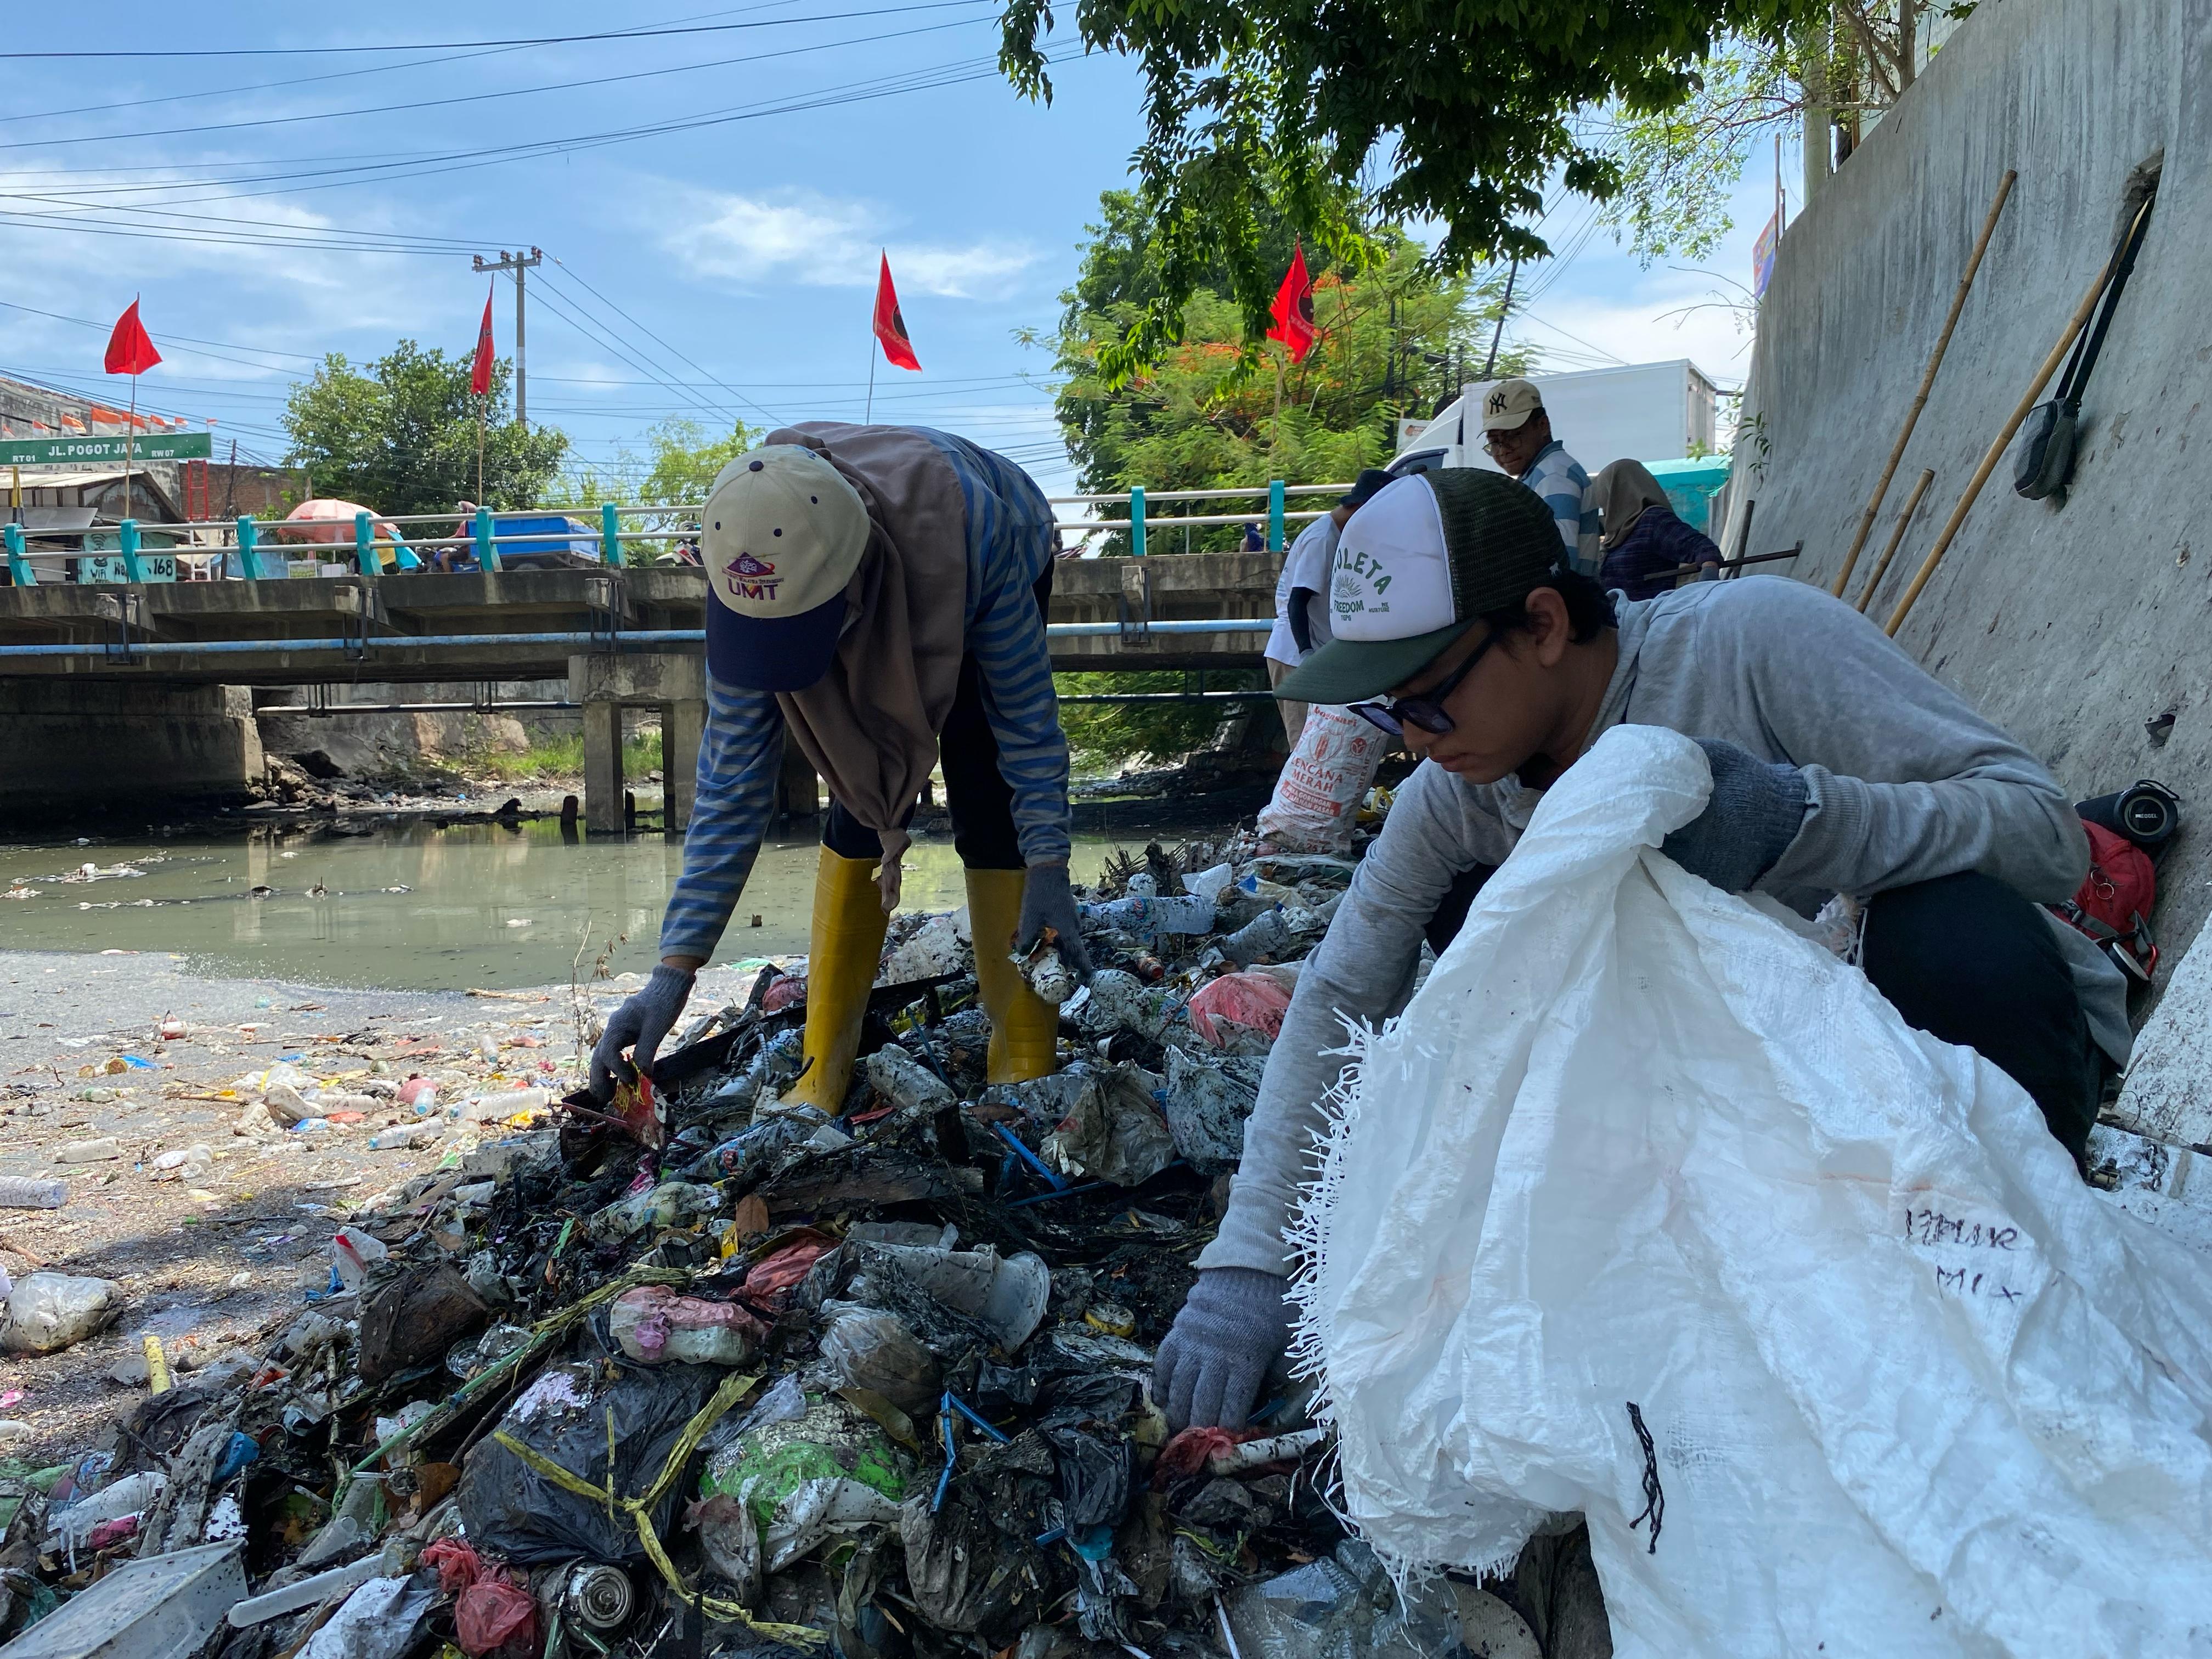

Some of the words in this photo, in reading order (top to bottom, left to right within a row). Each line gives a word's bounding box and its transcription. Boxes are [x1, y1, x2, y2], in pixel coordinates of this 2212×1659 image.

[48, 445, 66, 456] JL.
[68, 444, 110, 455] POGOT
[727, 578, 778, 600] UMT
[1334, 599, 1364, 613] FREEDOM
[1291, 755, 1343, 783] LENCANA
[1293, 769, 1334, 793] MERAH
[1937, 1265, 2023, 1304] MIX
